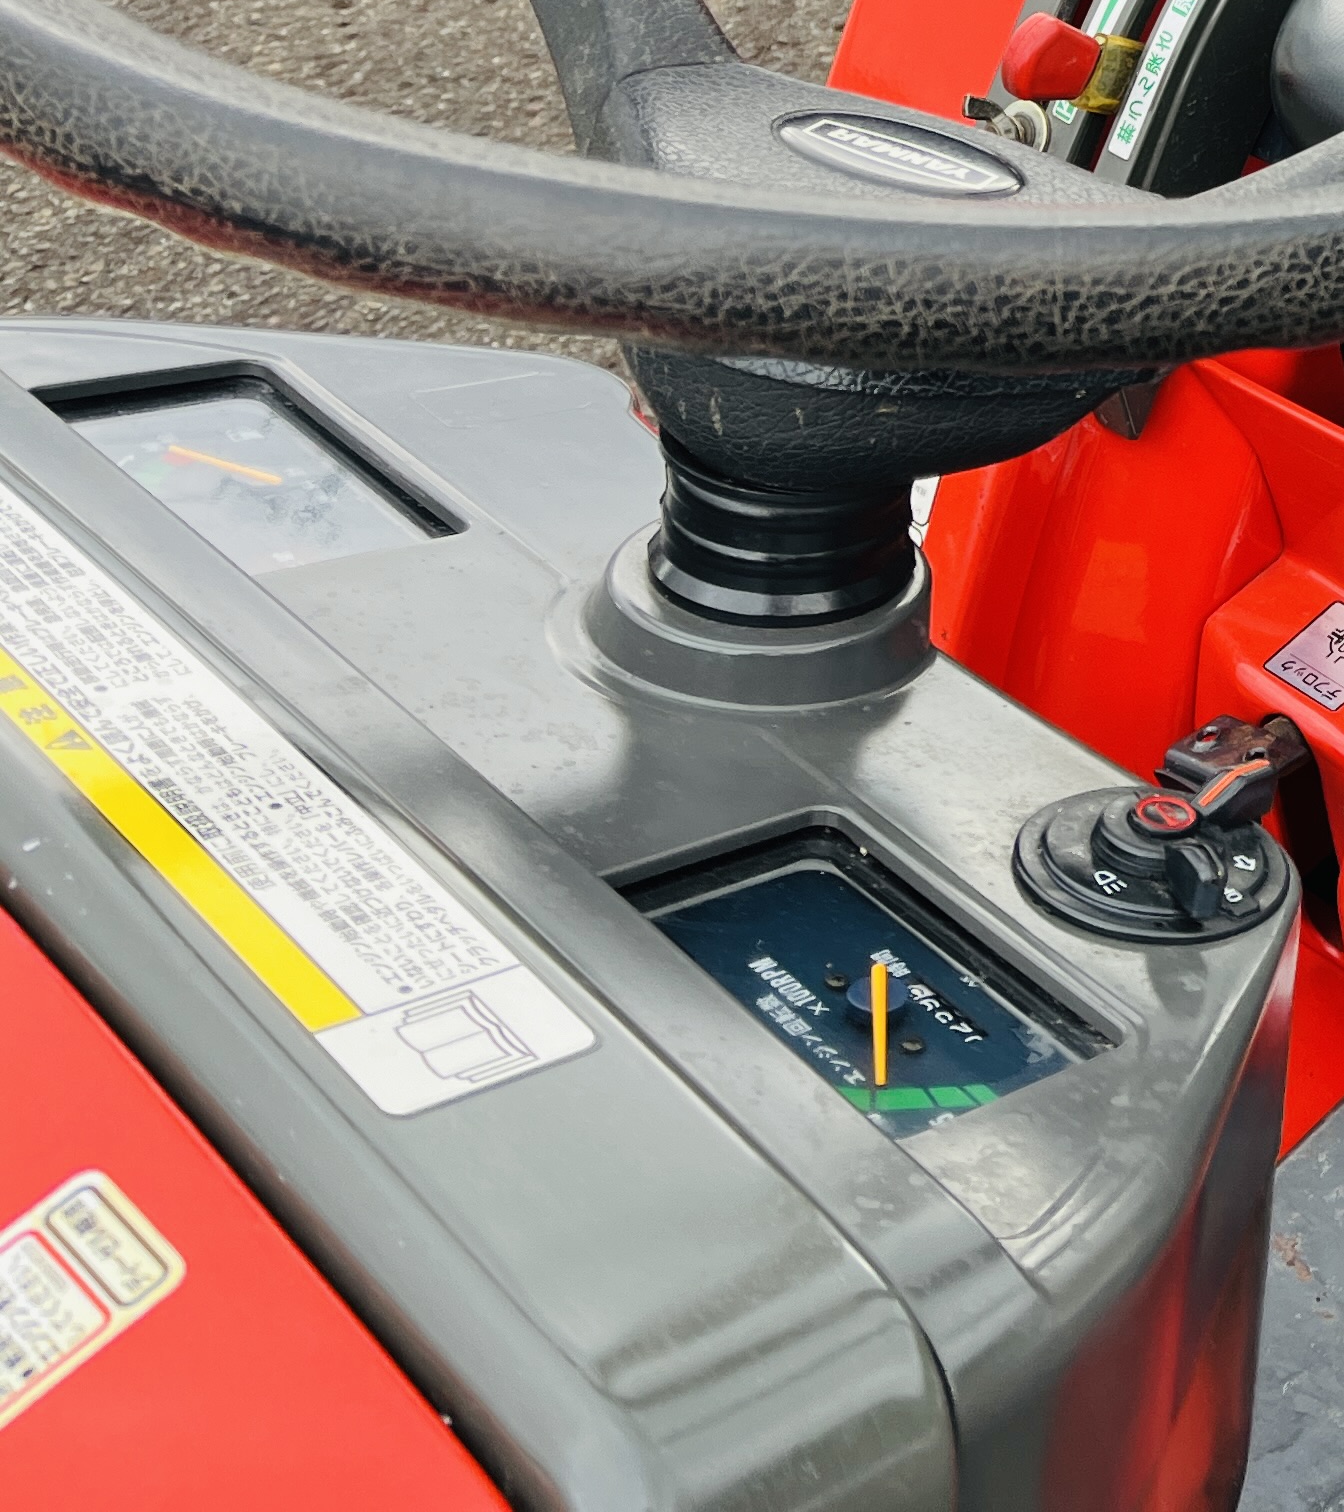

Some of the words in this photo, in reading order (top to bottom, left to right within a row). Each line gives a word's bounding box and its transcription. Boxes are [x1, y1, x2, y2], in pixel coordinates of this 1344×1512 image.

[826, 128, 971, 179] YANMAR
[1277, 656, 1342, 702] デフロック
[753, 990, 866, 1086] エンジン回転数
